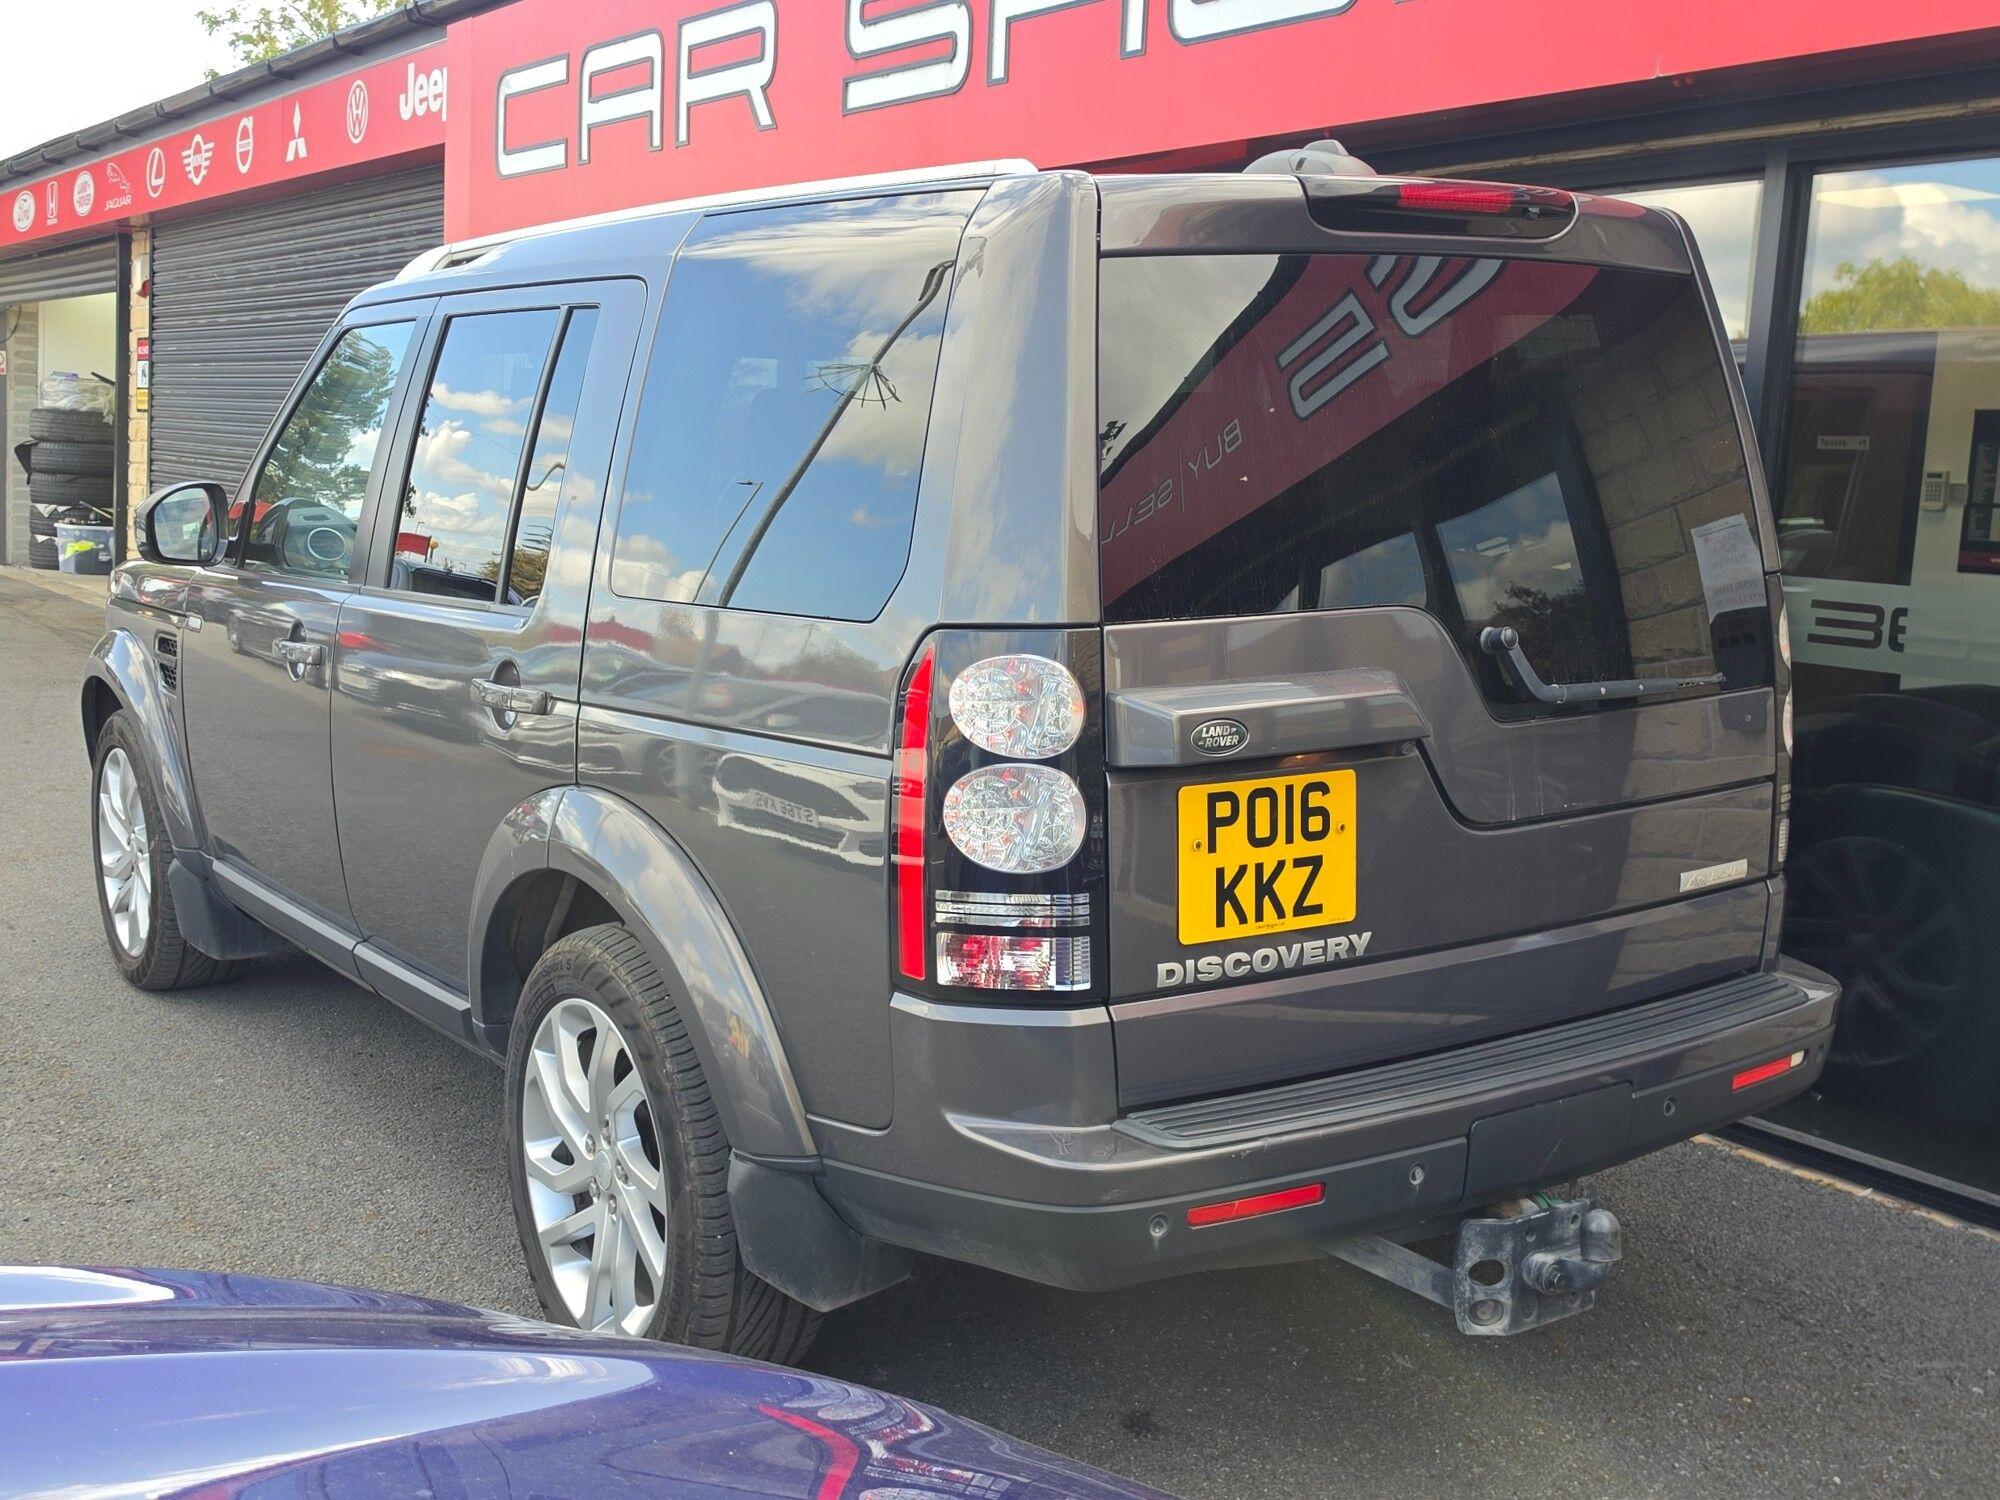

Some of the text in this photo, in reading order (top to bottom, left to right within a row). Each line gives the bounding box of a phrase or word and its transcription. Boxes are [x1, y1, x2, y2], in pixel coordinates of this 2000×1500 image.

[495, 0, 777, 180] CAR
[104, 195, 132, 211] JAGUAR
[1201, 725, 1231, 738] LAND
[1204, 735, 1240, 748] ROVER
[1206, 780, 1331, 855] PO16
[1215, 854, 1324, 929] KKZ
[1156, 931, 1372, 989] DISCOVERY
